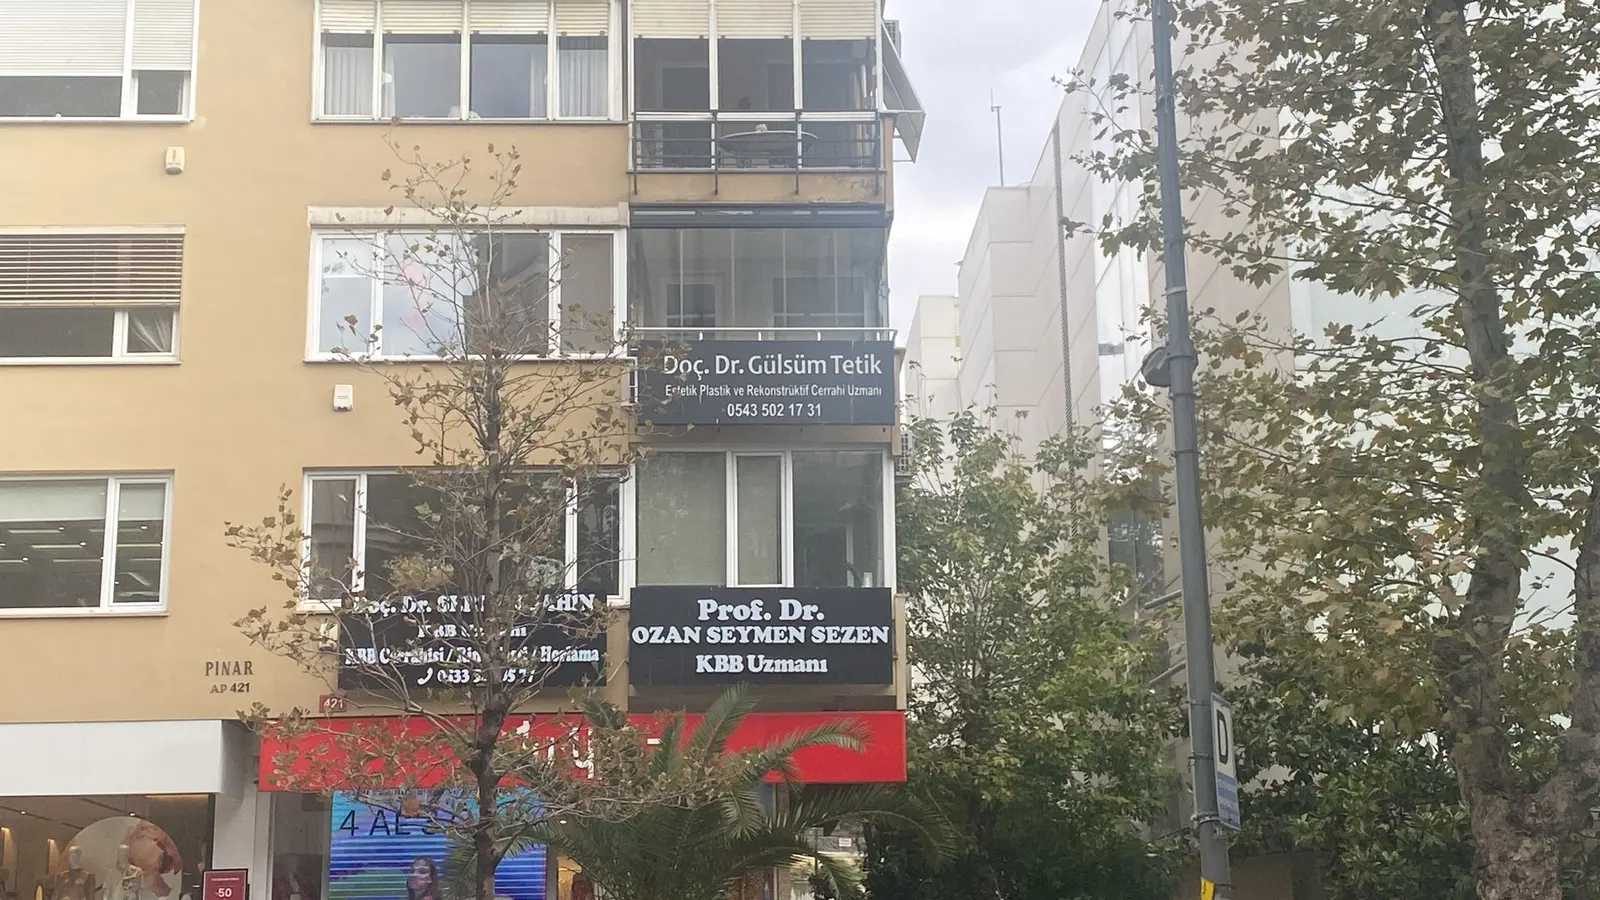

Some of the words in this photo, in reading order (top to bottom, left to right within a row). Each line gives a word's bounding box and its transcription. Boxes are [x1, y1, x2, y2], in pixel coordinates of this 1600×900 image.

[664, 355, 709, 381] Doç.
[715, 355, 744, 374] Dr.
[748, 354, 827, 375] Gülsüm
[830, 354, 882, 375] Tetik
[665, 384, 698, 397] Estetik
[700, 384, 731, 397] Plastik
[733, 387, 744, 397] ve
[746, 384, 809, 397] Rekonstrüktif
[811, 384, 845, 397] Cerrahi
[847, 384, 882, 397] Uzmanı
[727, 403, 758, 417] 0543
[761, 403, 784, 417] 502
[788, 403, 803, 417] 17
[807, 403, 821, 417] 31
[401, 596, 432, 613] Dr.
[697, 599, 772, 621] Prof.
[779, 599, 825, 621] Dr.
[631, 626, 702, 644] OZAN
[706, 626, 806, 644] SEYMEN
[810, 626, 889, 644] SEZEN
[696, 655, 744, 673] KBB
[747, 655, 828, 673] Uzmanı
[230, 682, 250, 693] 421
[1216, 709, 1228, 765] D
[339, 809, 359, 836] 4
